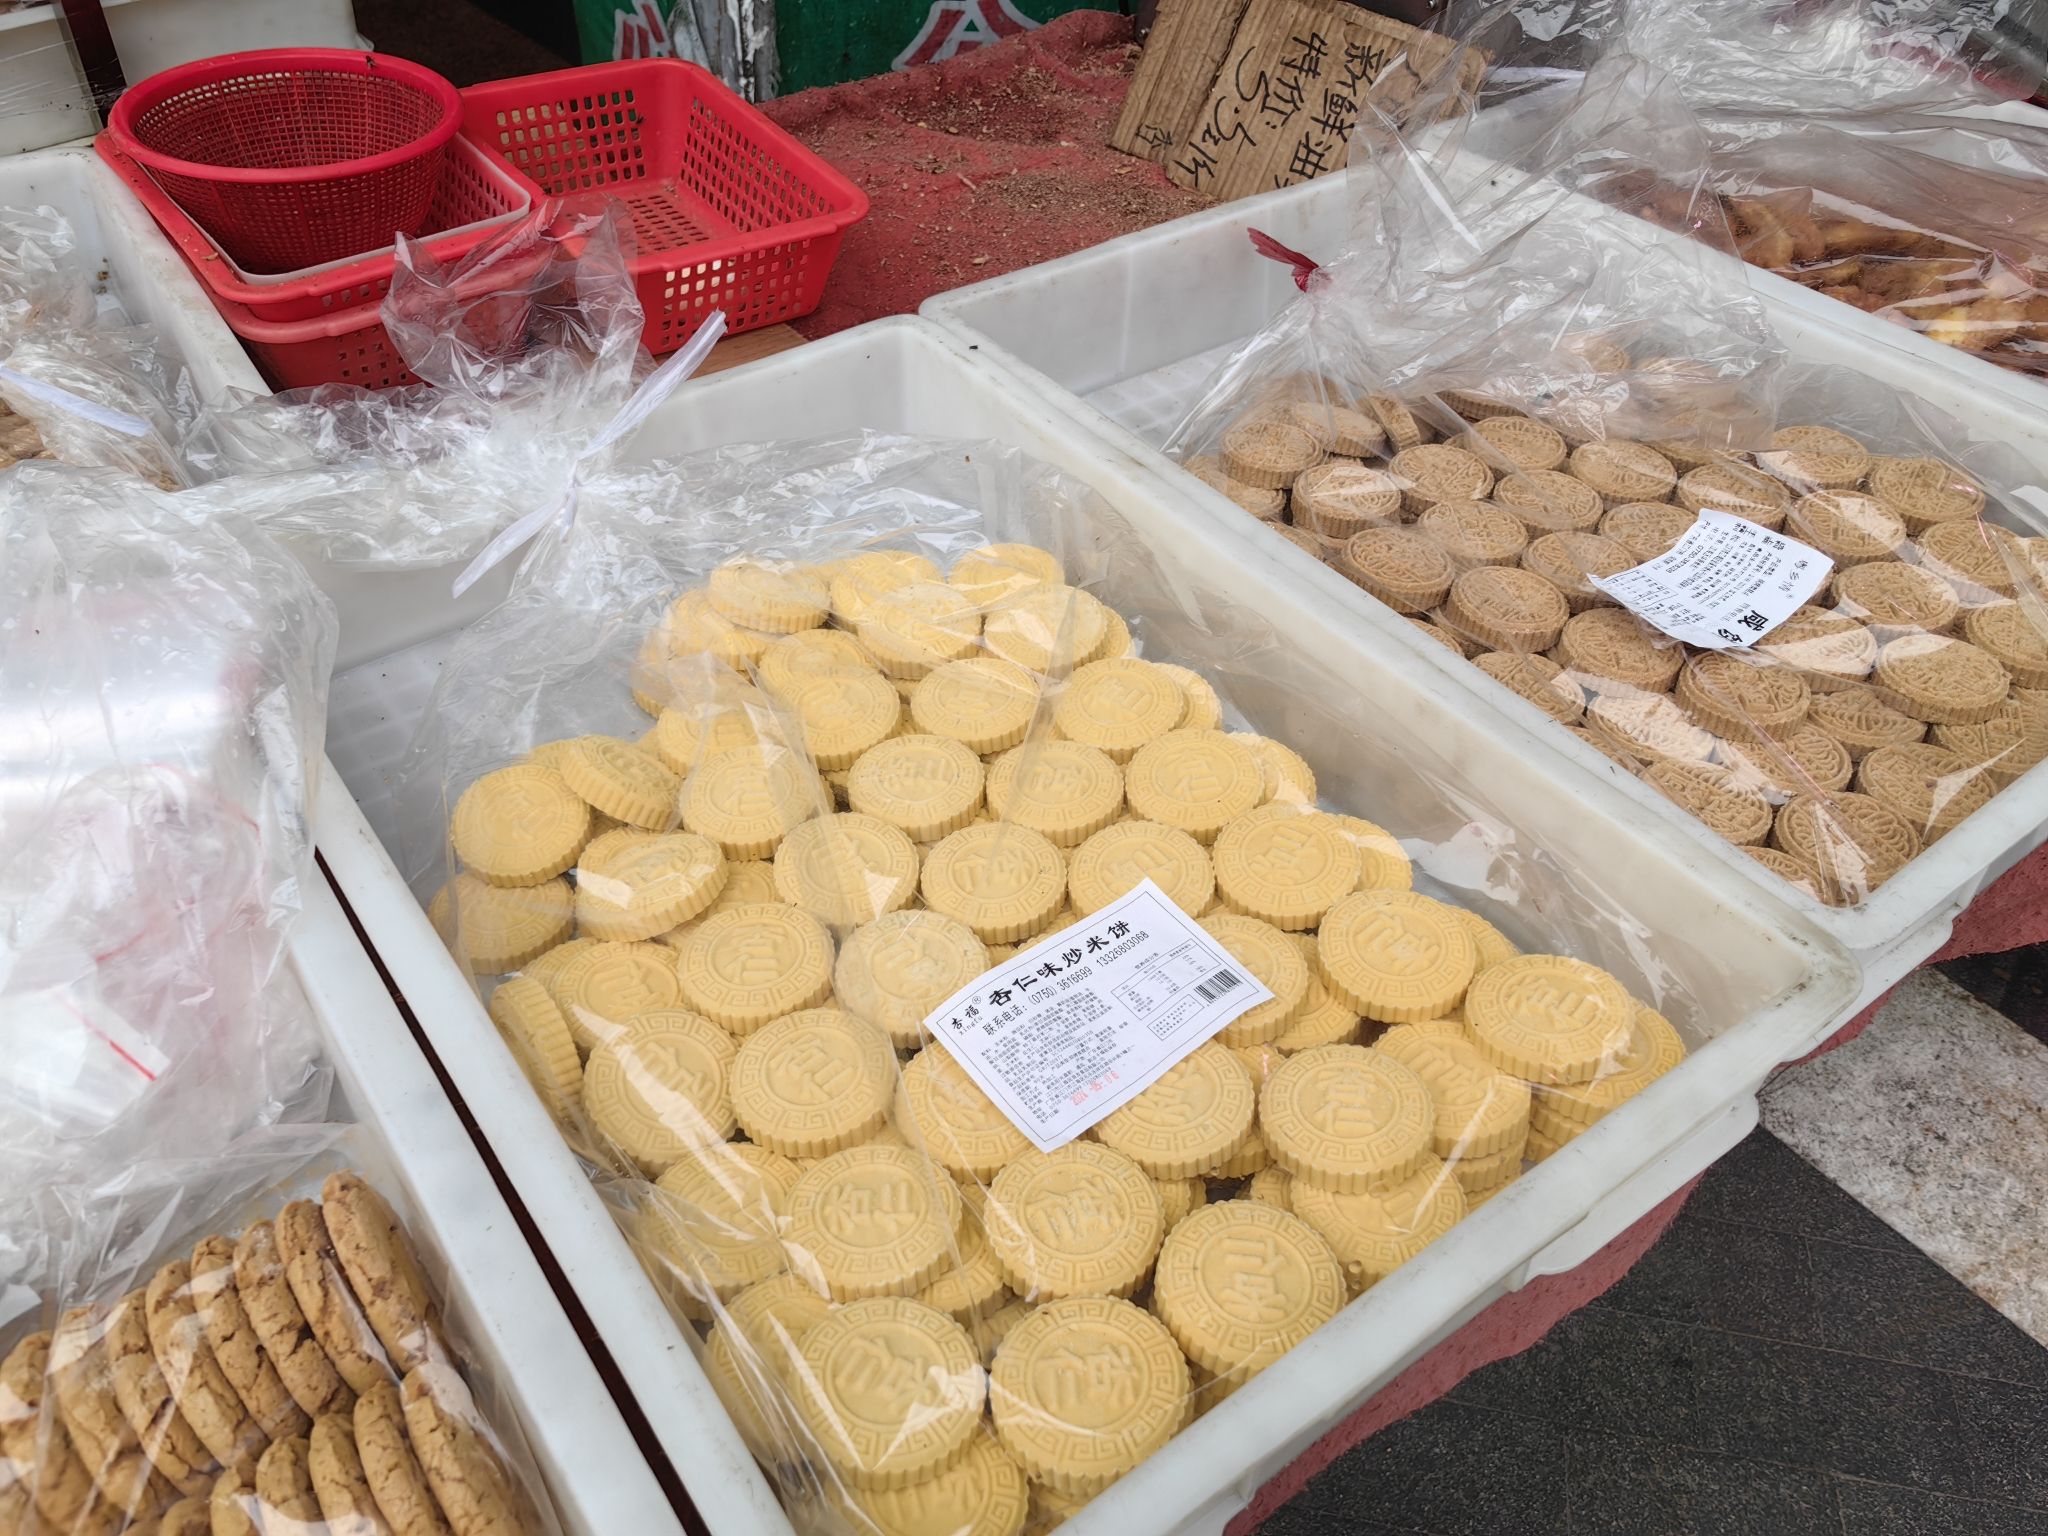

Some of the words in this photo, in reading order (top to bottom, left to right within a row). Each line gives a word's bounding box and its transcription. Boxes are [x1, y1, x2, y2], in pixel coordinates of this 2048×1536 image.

[982, 1004, 1028, 1036] 联系电话:
[1028, 986, 1057, 1007] (0750)
[1057, 965, 1093, 991] 3616699
[1096, 930, 1150, 968] 13326803068
[989, 920, 1131, 1006] 杏仁味炒米饼
[951, 1004, 980, 1030] 杏福
